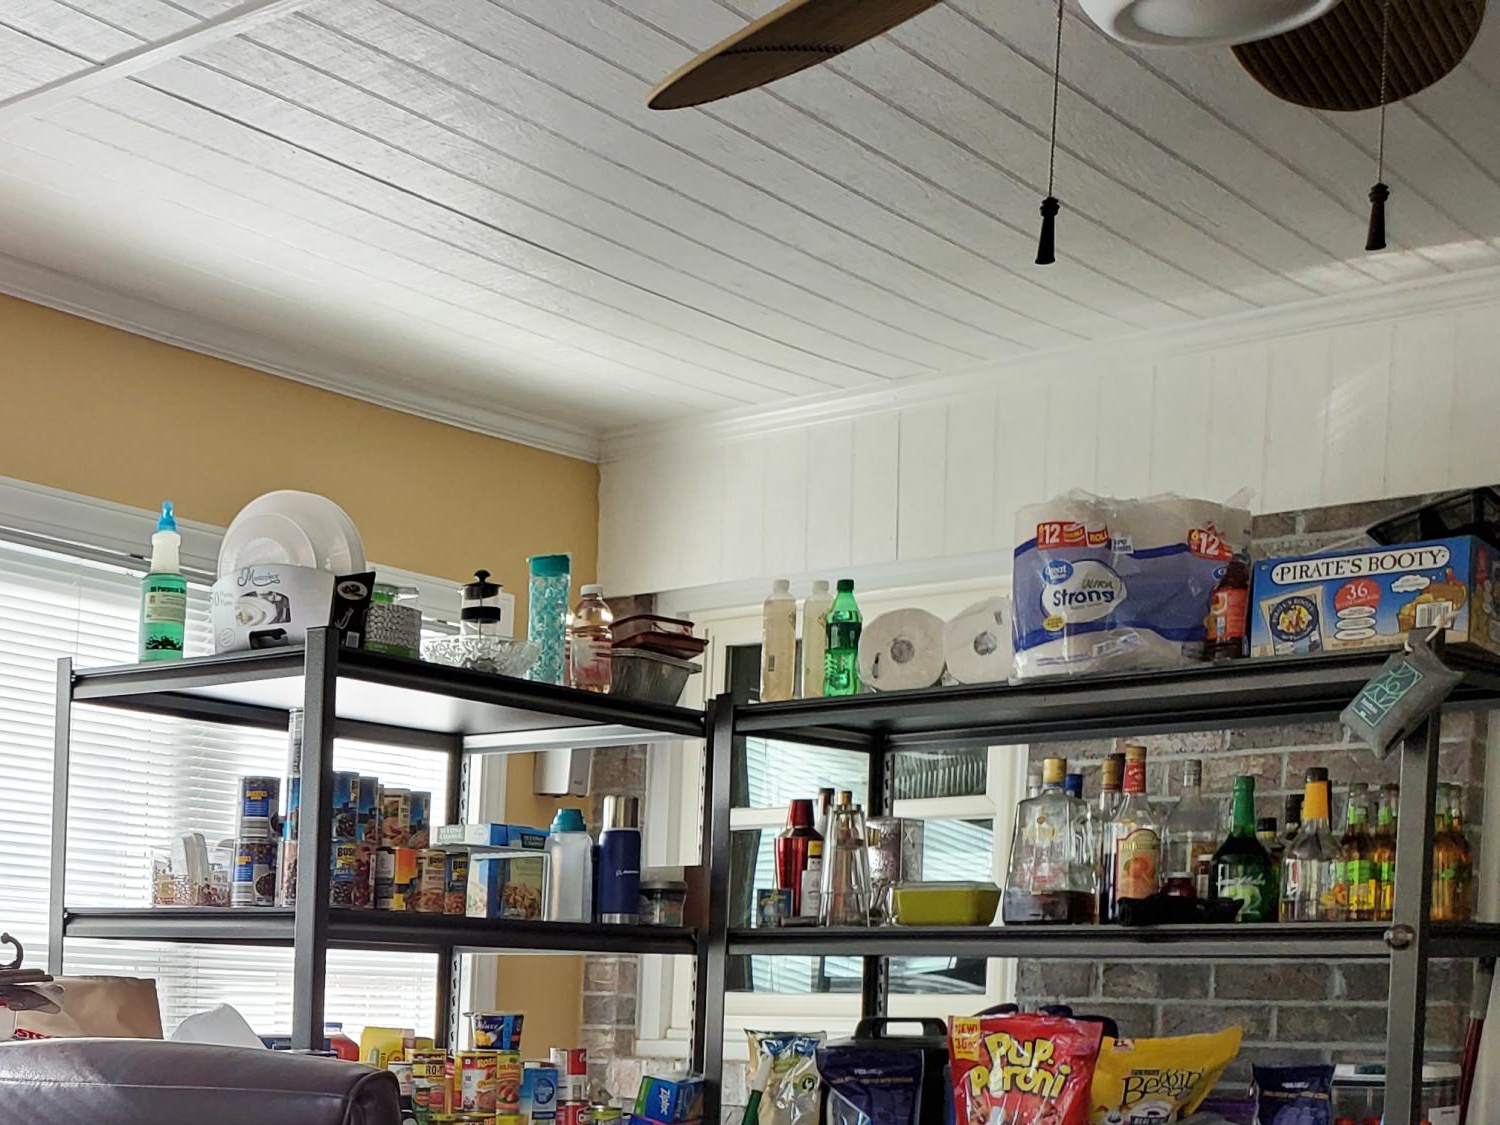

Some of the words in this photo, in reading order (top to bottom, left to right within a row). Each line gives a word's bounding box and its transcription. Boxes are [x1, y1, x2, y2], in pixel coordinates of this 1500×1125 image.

[1280, 557, 1363, 582] PIRATE'S
[1367, 548, 1441, 572] BOOTY
[1052, 588, 1115, 608] Strong
